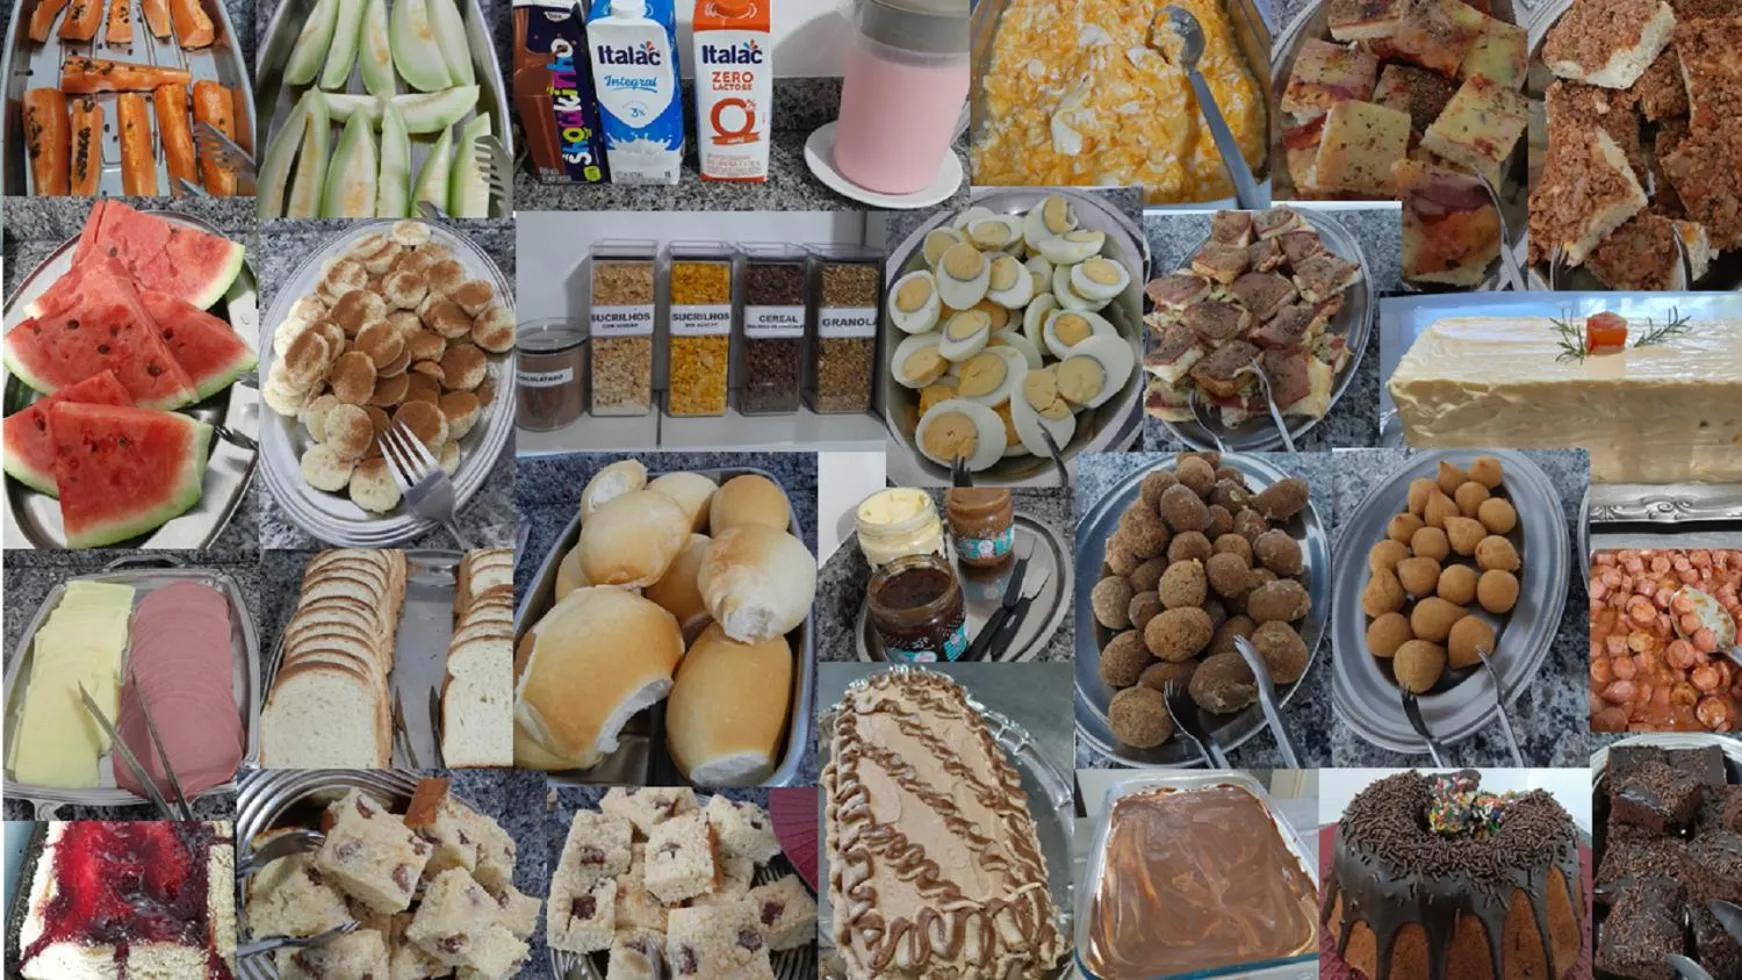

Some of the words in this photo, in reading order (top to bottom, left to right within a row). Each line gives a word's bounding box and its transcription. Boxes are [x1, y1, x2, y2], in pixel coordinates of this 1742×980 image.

[597, 45, 662, 66] Italac
[702, 44, 763, 64] Italac
[603, 75, 658, 90] Integral
[712, 71, 754, 83] ZERO
[591, 312, 650, 322] SUCRILHOS
[672, 312, 730, 321] SUCRILHOS
[759, 314, 799, 323] CEREAL
